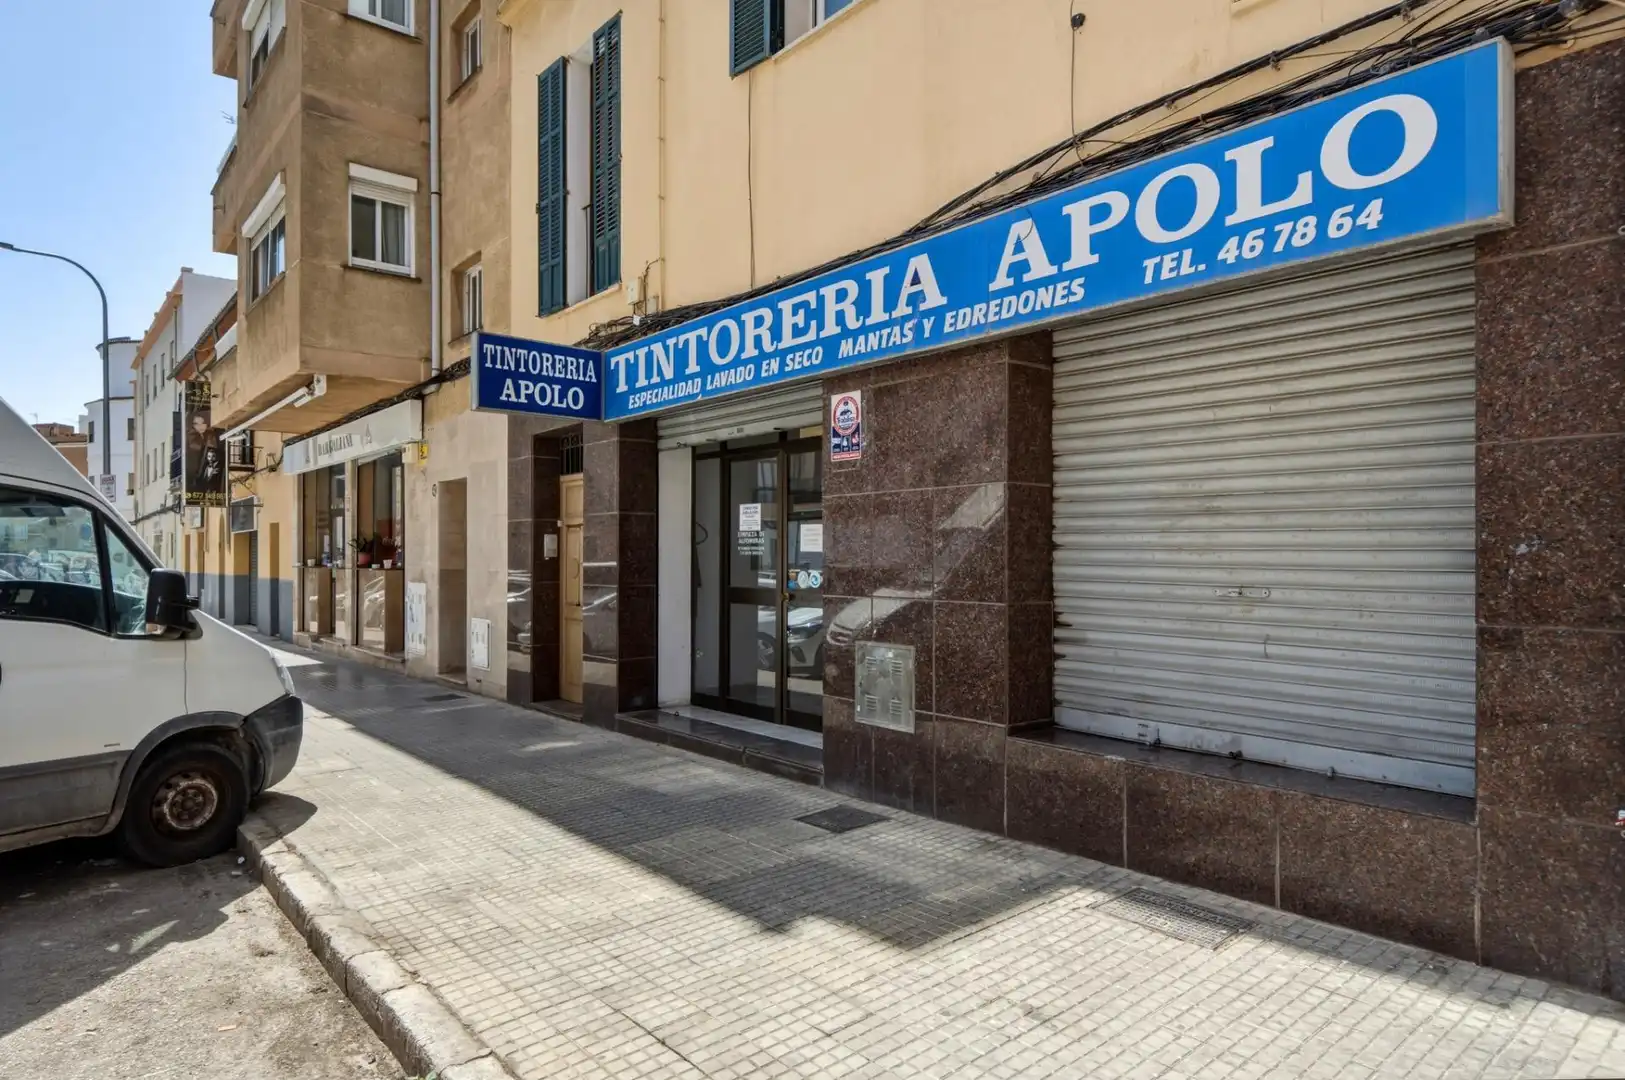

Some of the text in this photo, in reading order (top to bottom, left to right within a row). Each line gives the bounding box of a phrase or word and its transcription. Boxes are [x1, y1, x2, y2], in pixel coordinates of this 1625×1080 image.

[610, 93, 1438, 393] TINTORERIA APOLO
[1142, 198, 1384, 284] TEL. 46 78 64
[483, 343, 597, 383] TINTORERIA
[628, 277, 1085, 409] ESPECIALIDAD LAVADO EN SECO MANTAS Y EDREDONES
[500, 378, 585, 410] APOLO
